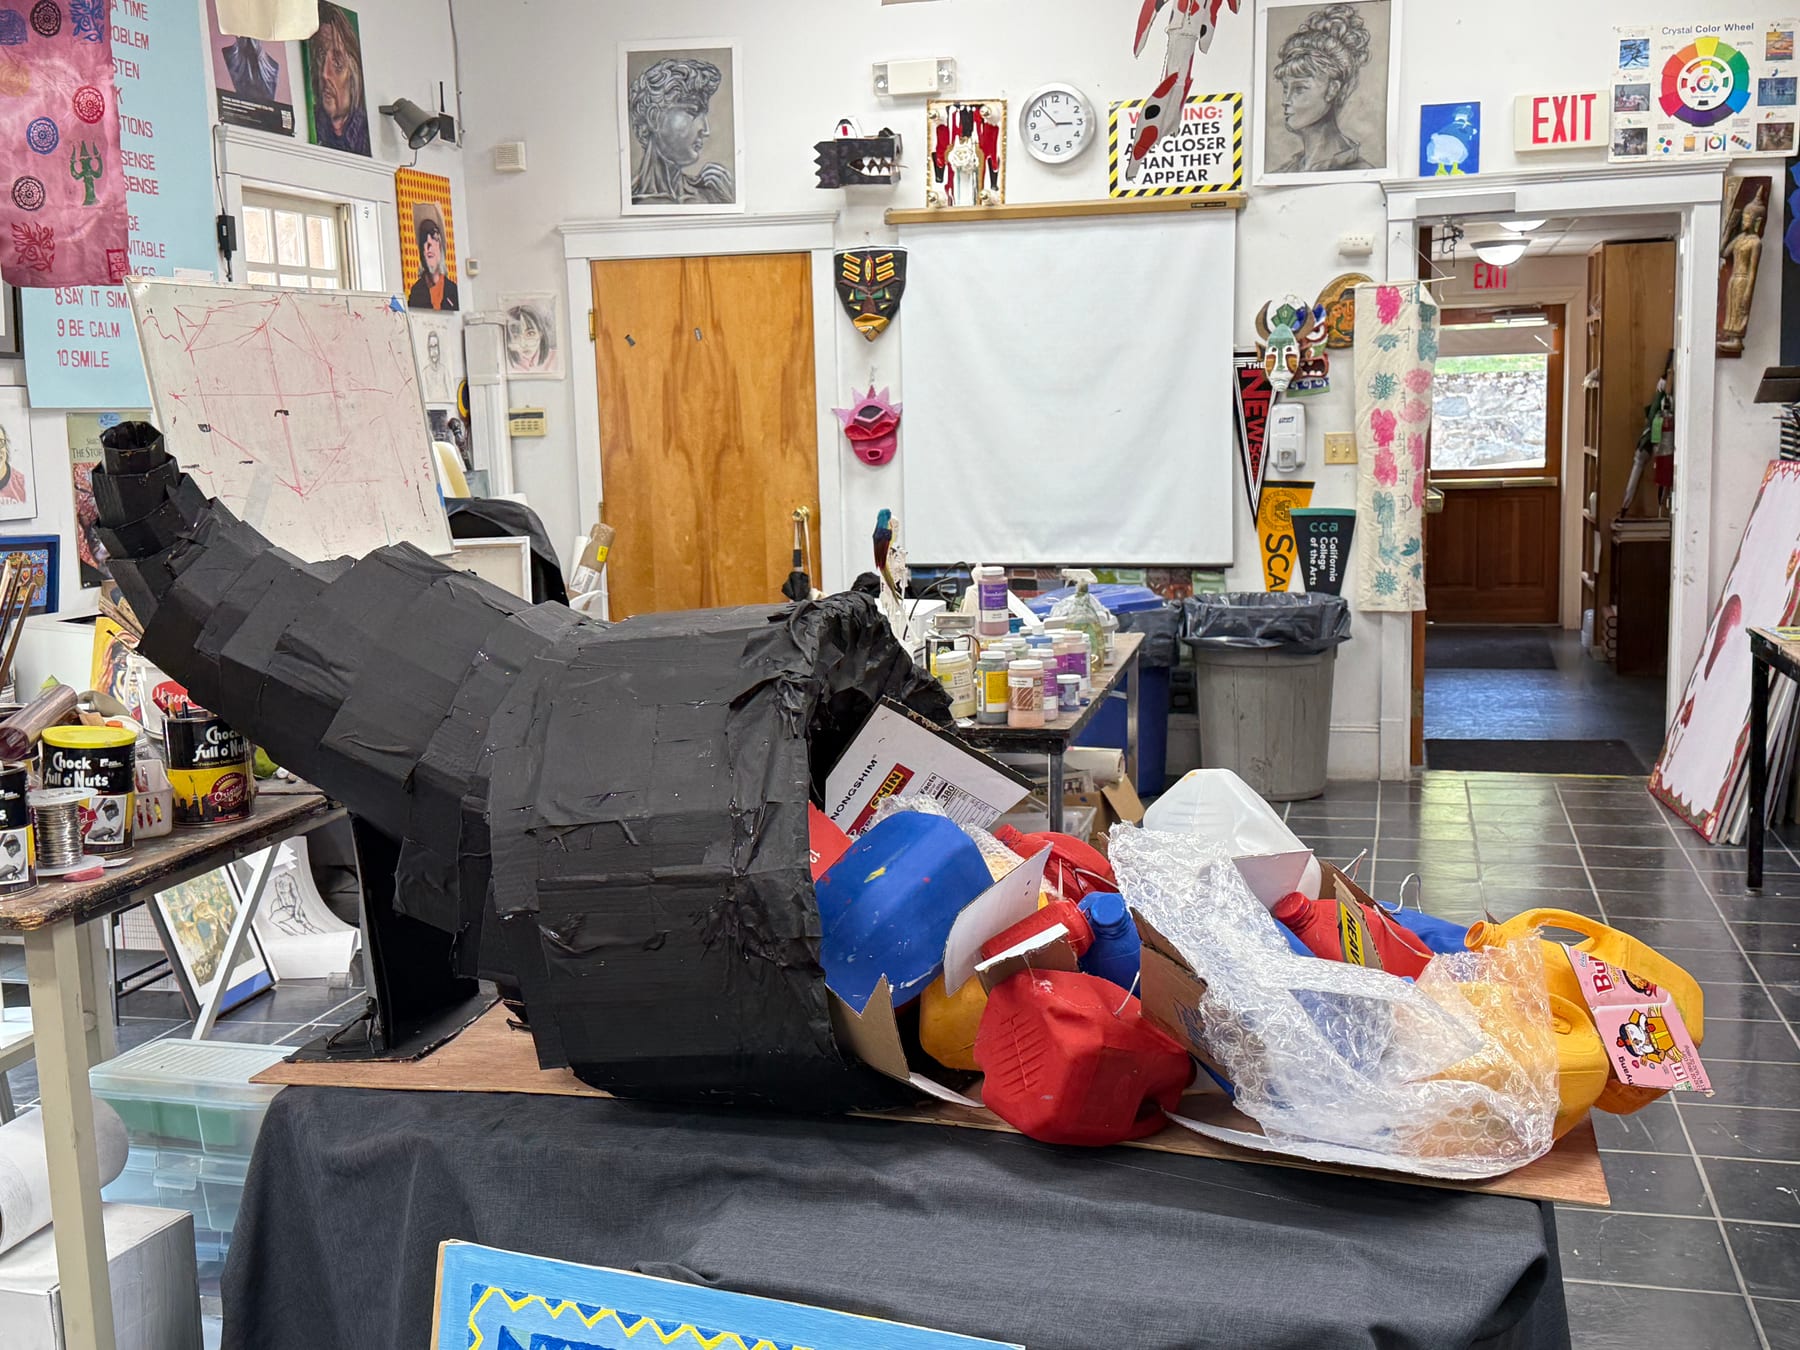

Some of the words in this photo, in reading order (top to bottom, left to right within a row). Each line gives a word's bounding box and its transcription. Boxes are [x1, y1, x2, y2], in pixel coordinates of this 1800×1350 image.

[123, 0, 149, 21] TIME
[112, 25, 149, 50] OBLEM
[1662, 26, 1692, 35] Crystal
[1695, 24, 1720, 33] Color
[1724, 22, 1754, 31] Wheel
[112, 57, 140, 79] STEN
[1041, 99, 1047, 107] 11
[1051, 95, 1060, 103] 12
[1032, 109, 1041, 118] 10
[1128, 106, 1223, 124] WING:
[1532, 93, 1597, 144] EXIT
[120, 114, 154, 138] TIONS
[1030, 122, 1036, 130] 9
[1177, 121, 1220, 137] ATES
[1124, 142, 1155, 156] AE
[1162, 136, 1226, 153] CLOSER
[1127, 154, 1174, 170] HAN
[1180, 151, 1223, 167] THEY
[1142, 168, 1208, 185] APPEAR
[54, 287, 63, 306] 8
[64, 287, 84, 306] SAY
[90, 289, 100, 307] IT
[106, 290, 130, 309] SIM
[57, 318, 65, 337] 9
[68, 319, 85, 337] BE
[89, 320, 121, 338] CALM
[56, 349, 69, 367] 10
[71, 349, 110, 368] SMILE
[1309, 521, 1339, 533] cca
[1310, 536, 1318, 547] of
[1309, 549, 1318, 564] the
[1318, 536, 1328, 570] College
[1329, 536, 1339, 582] California
[1309, 565, 1318, 586] Arts
[52, 751, 92, 773] Chock
[192, 743, 219, 762] full
[44, 767, 61, 786] full
[74, 770, 109, 789] Nuts
[830, 759, 878, 821] NONGSHIM
[1346, 910, 1361, 966] HEAV
